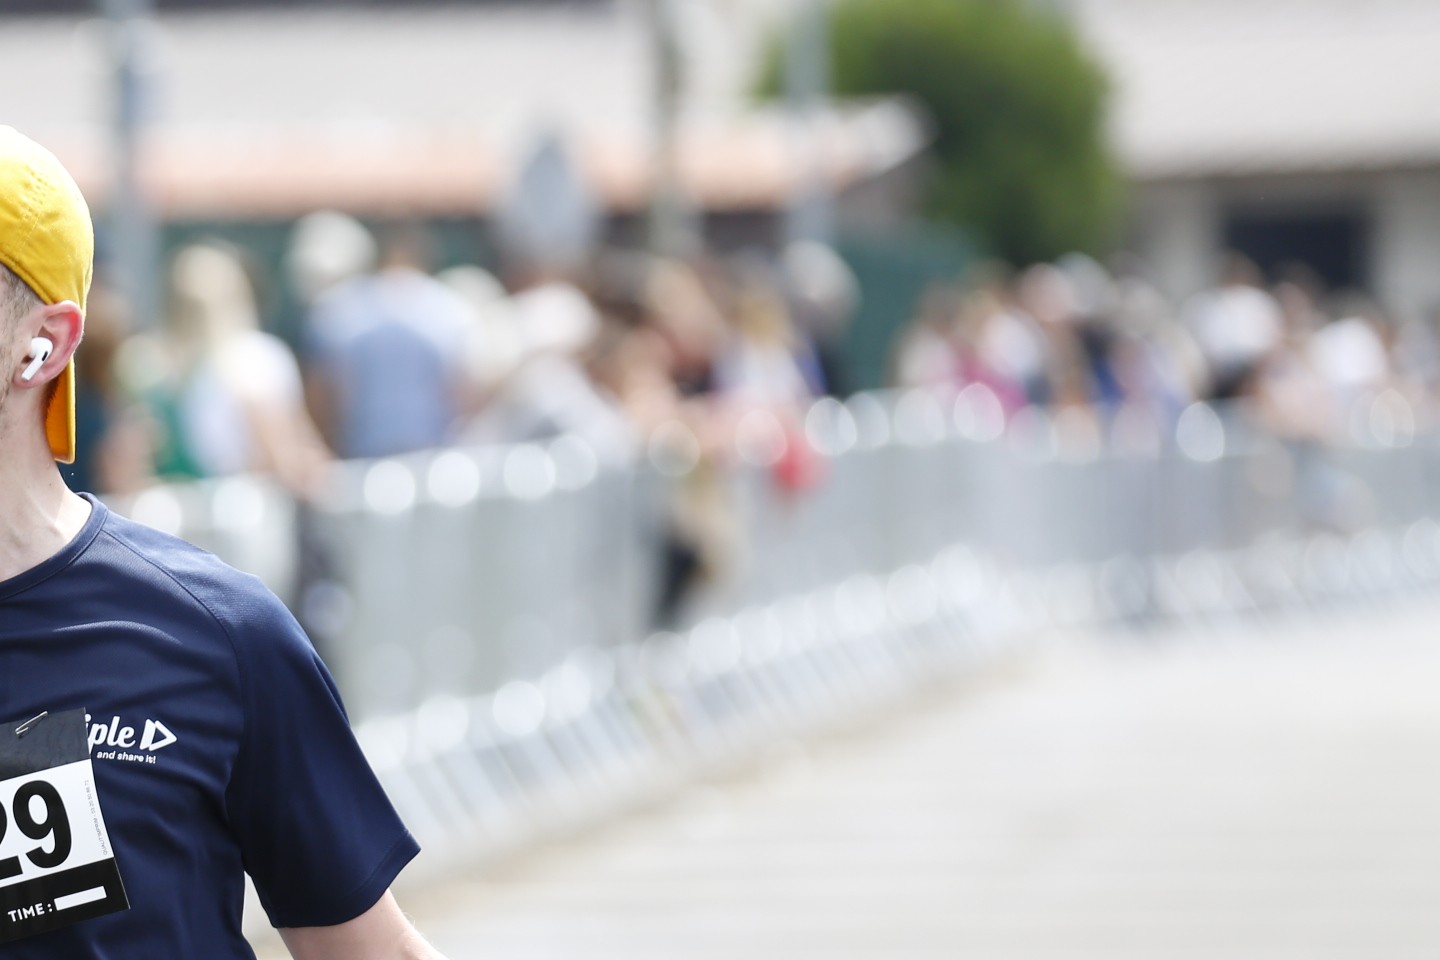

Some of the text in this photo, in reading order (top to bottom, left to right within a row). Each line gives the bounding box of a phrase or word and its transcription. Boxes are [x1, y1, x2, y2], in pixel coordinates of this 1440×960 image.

[96, 750, 157, 764] and share it!
[8, 903, 45, 923] TIME
